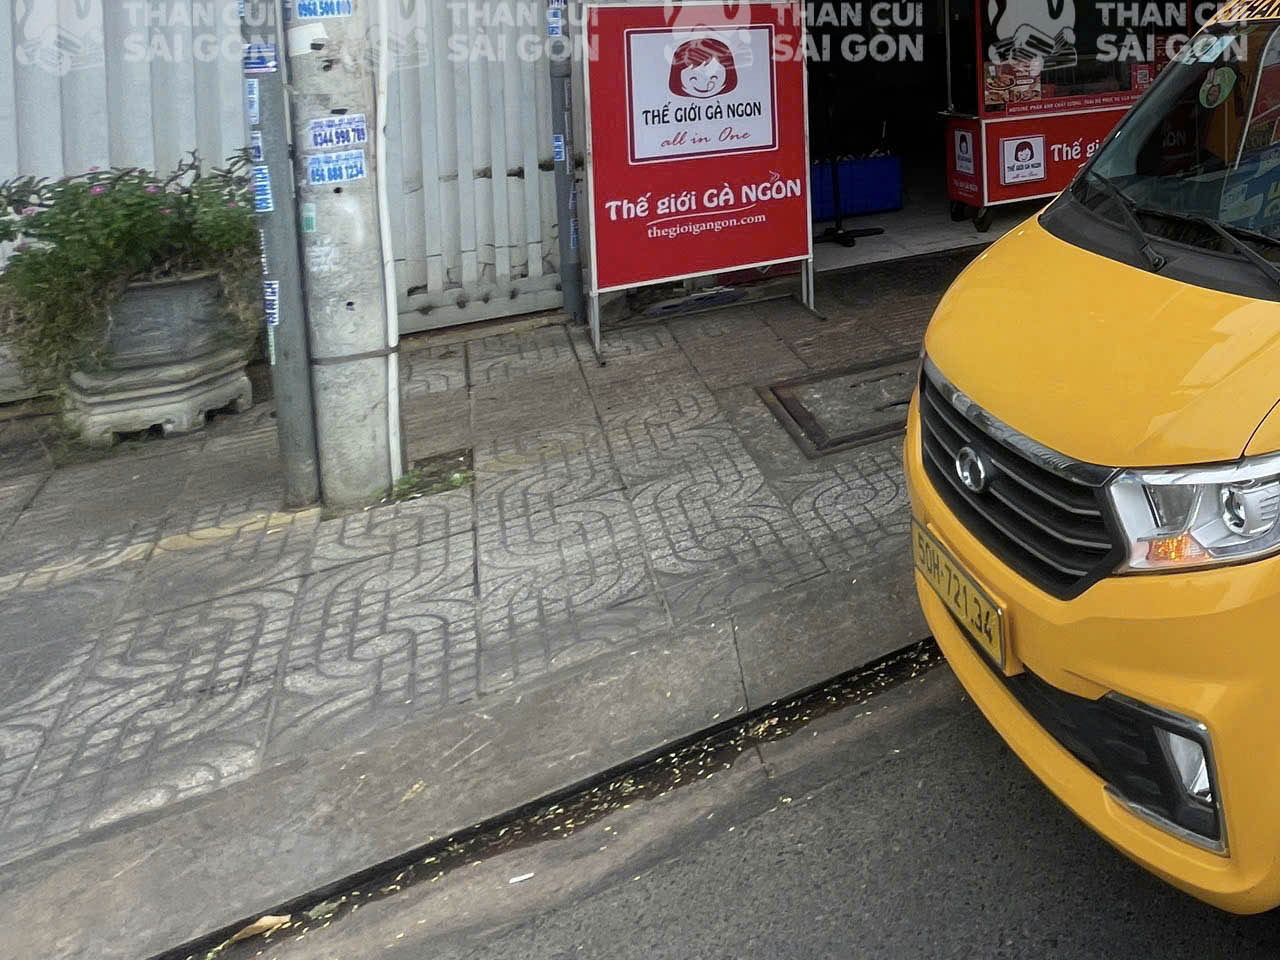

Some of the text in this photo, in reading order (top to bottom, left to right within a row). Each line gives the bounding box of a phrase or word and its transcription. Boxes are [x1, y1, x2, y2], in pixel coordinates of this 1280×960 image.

[643, 100, 762, 126] THẾ GIỚI GÀ NGON
[661, 126, 751, 148] all in One
[1050, 138, 1082, 162] Thế
[605, 191, 652, 221] Thế
[656, 191, 697, 215] giới
[703, 182, 735, 208] GÀ
[647, 213, 767, 239] thegioigangon.com
